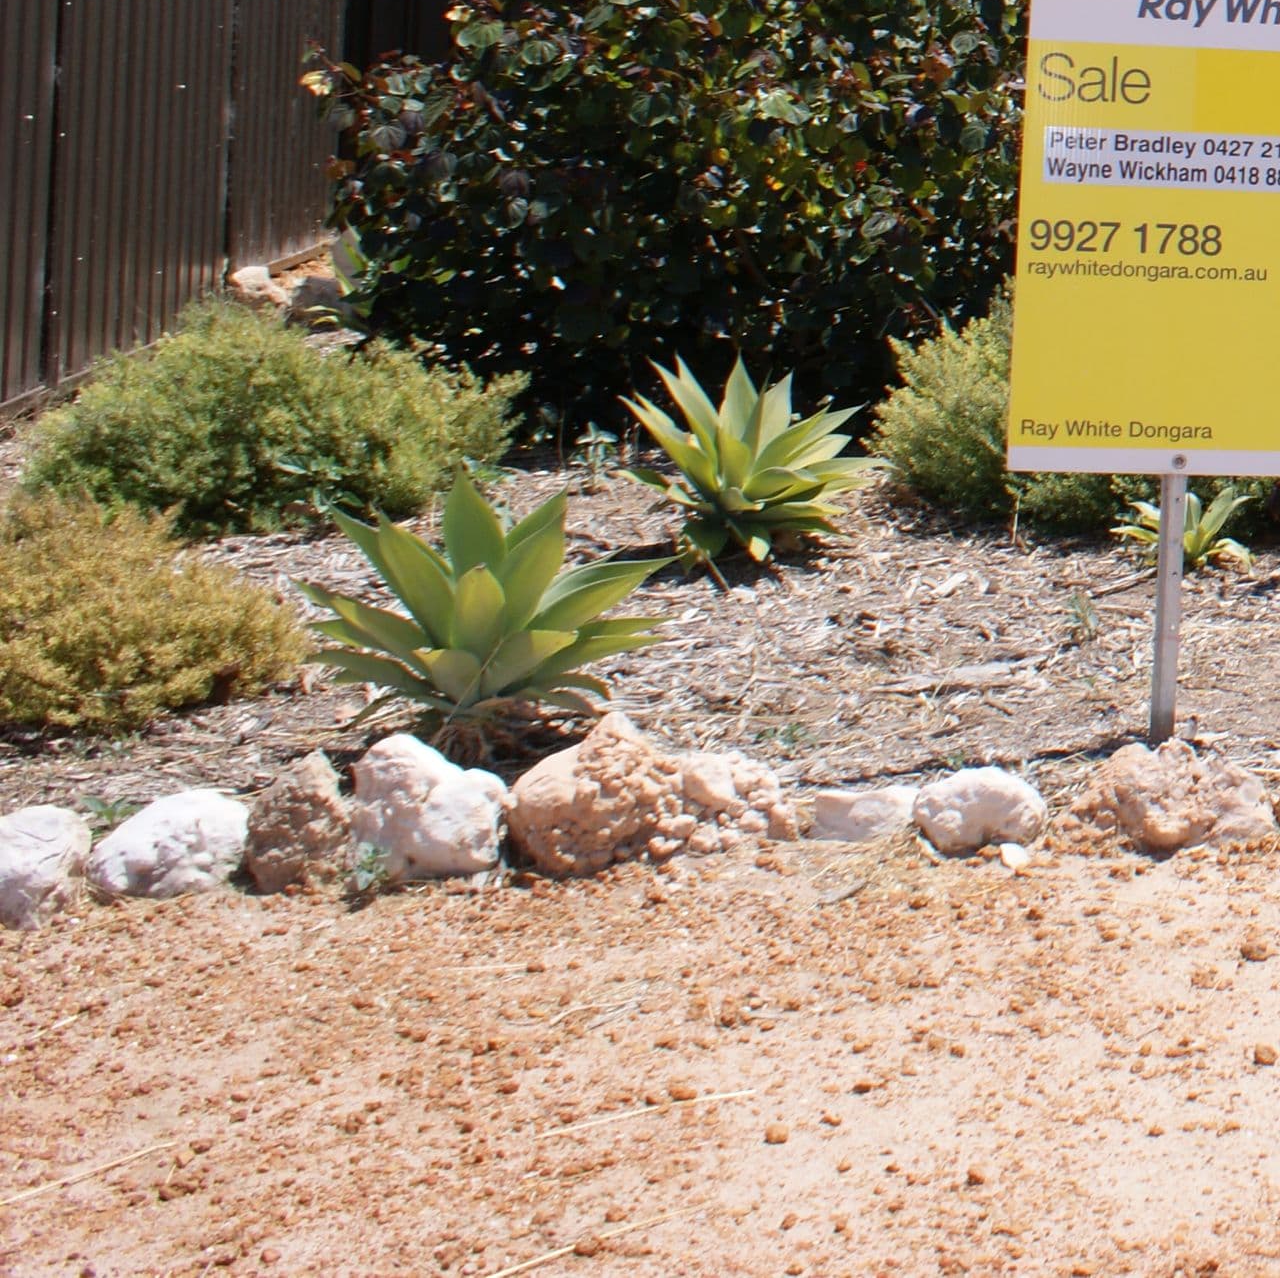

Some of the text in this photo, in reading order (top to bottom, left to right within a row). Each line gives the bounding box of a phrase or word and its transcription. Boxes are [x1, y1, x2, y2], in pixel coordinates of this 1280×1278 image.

[1038, 53, 1151, 104] Sale
[1050, 131, 1108, 151] Peter
[1113, 134, 1197, 159] Bradley
[1203, 139, 1254, 158] 0427
[1047, 157, 1113, 180] Wayne
[1118, 160, 1208, 184] Wickham
[1214, 165, 1260, 185] 0418
[1029, 219, 1223, 256] 9927 1788
[1027, 259, 1269, 282] raywhitedongara.com.au
[1019, 419, 1213, 443] Ray White Dongara
